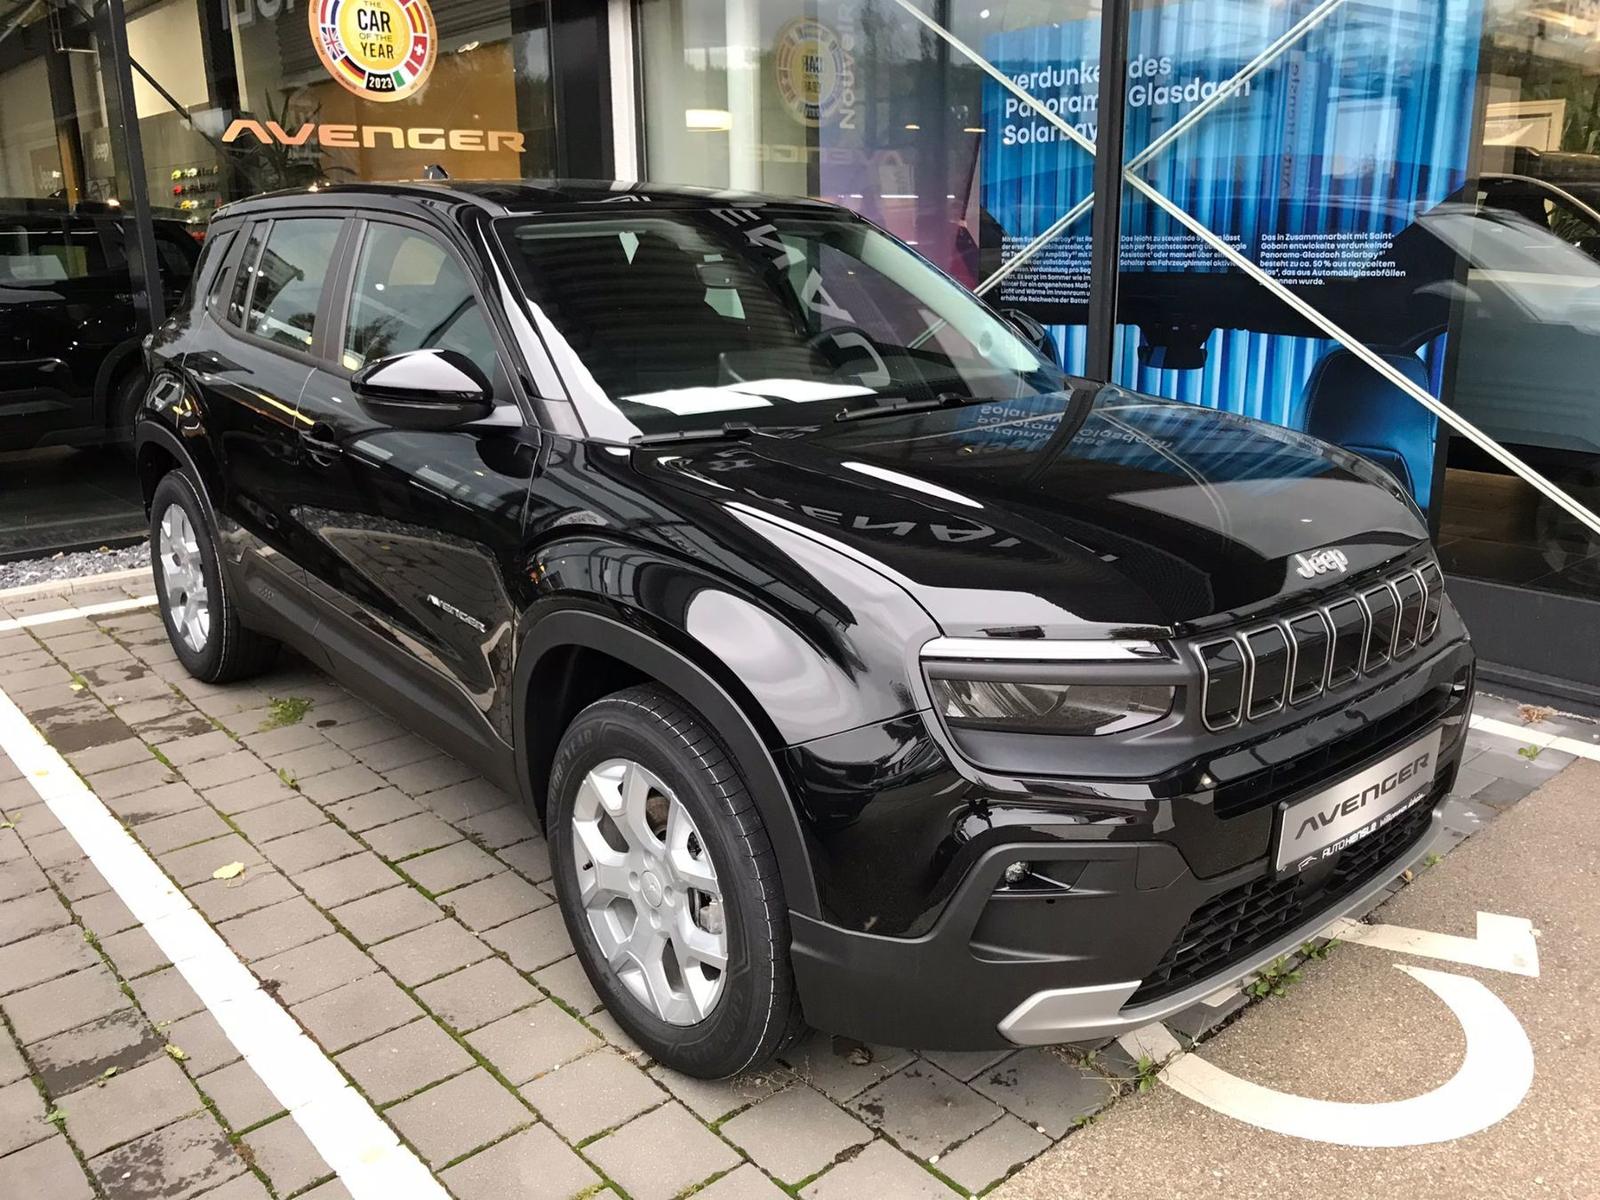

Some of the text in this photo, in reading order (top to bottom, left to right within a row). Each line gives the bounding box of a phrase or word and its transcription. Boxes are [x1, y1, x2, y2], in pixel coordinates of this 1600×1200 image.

[357, 8, 392, 33] CAR
[359, 32, 393, 43] OF THE
[360, 42, 395, 59] YEAR
[1128, 54, 1173, 79] des
[368, 76, 393, 89] 2023
[221, 118, 527, 153] AVENGER
[1285, 233, 1353, 241] Zusammenarbeit
[1354, 232, 1368, 240] mit
[1370, 232, 1395, 240] Saint-
[1260, 241, 1394, 250] Gobain entwickelte verdunkelnde
[1260, 250, 1341, 259] Panorama-Glasdach
[1348, 260, 1396, 269] recyceltem
[1281, 268, 1296, 276] das
[1311, 269, 1406, 278] Automobilglasabfällen
[1294, 549, 1349, 579] Jeep
[426, 594, 487, 634] AVENGER
[1294, 752, 1430, 841] AVENGER
